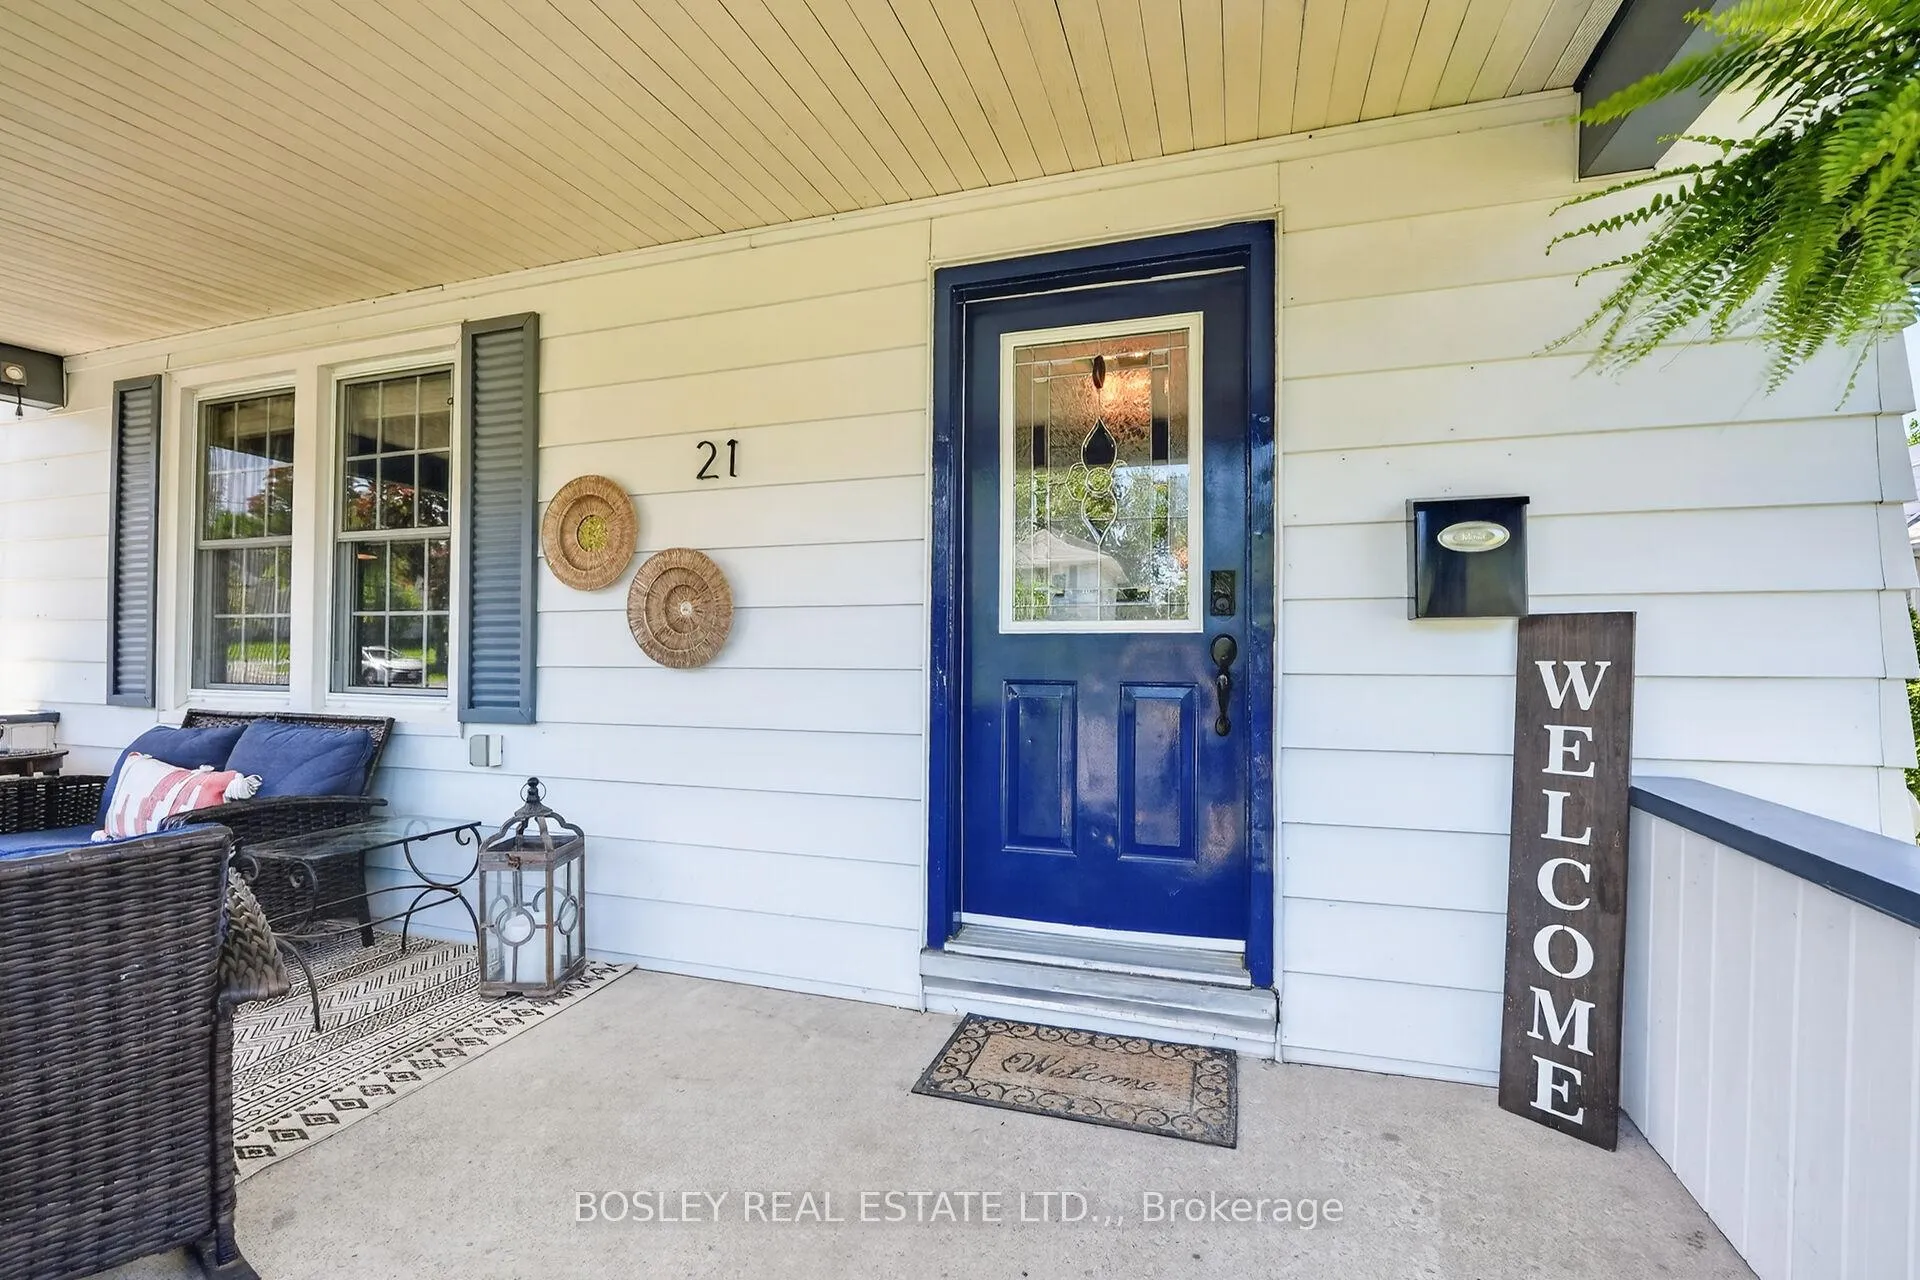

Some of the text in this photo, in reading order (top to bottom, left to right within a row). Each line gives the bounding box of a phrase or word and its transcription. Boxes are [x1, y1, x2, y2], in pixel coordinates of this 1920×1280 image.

[696, 439, 739, 480] 21
[1526, 660, 1612, 1126] WELCOME
[1001, 1052, 1164, 1092] Welcome
